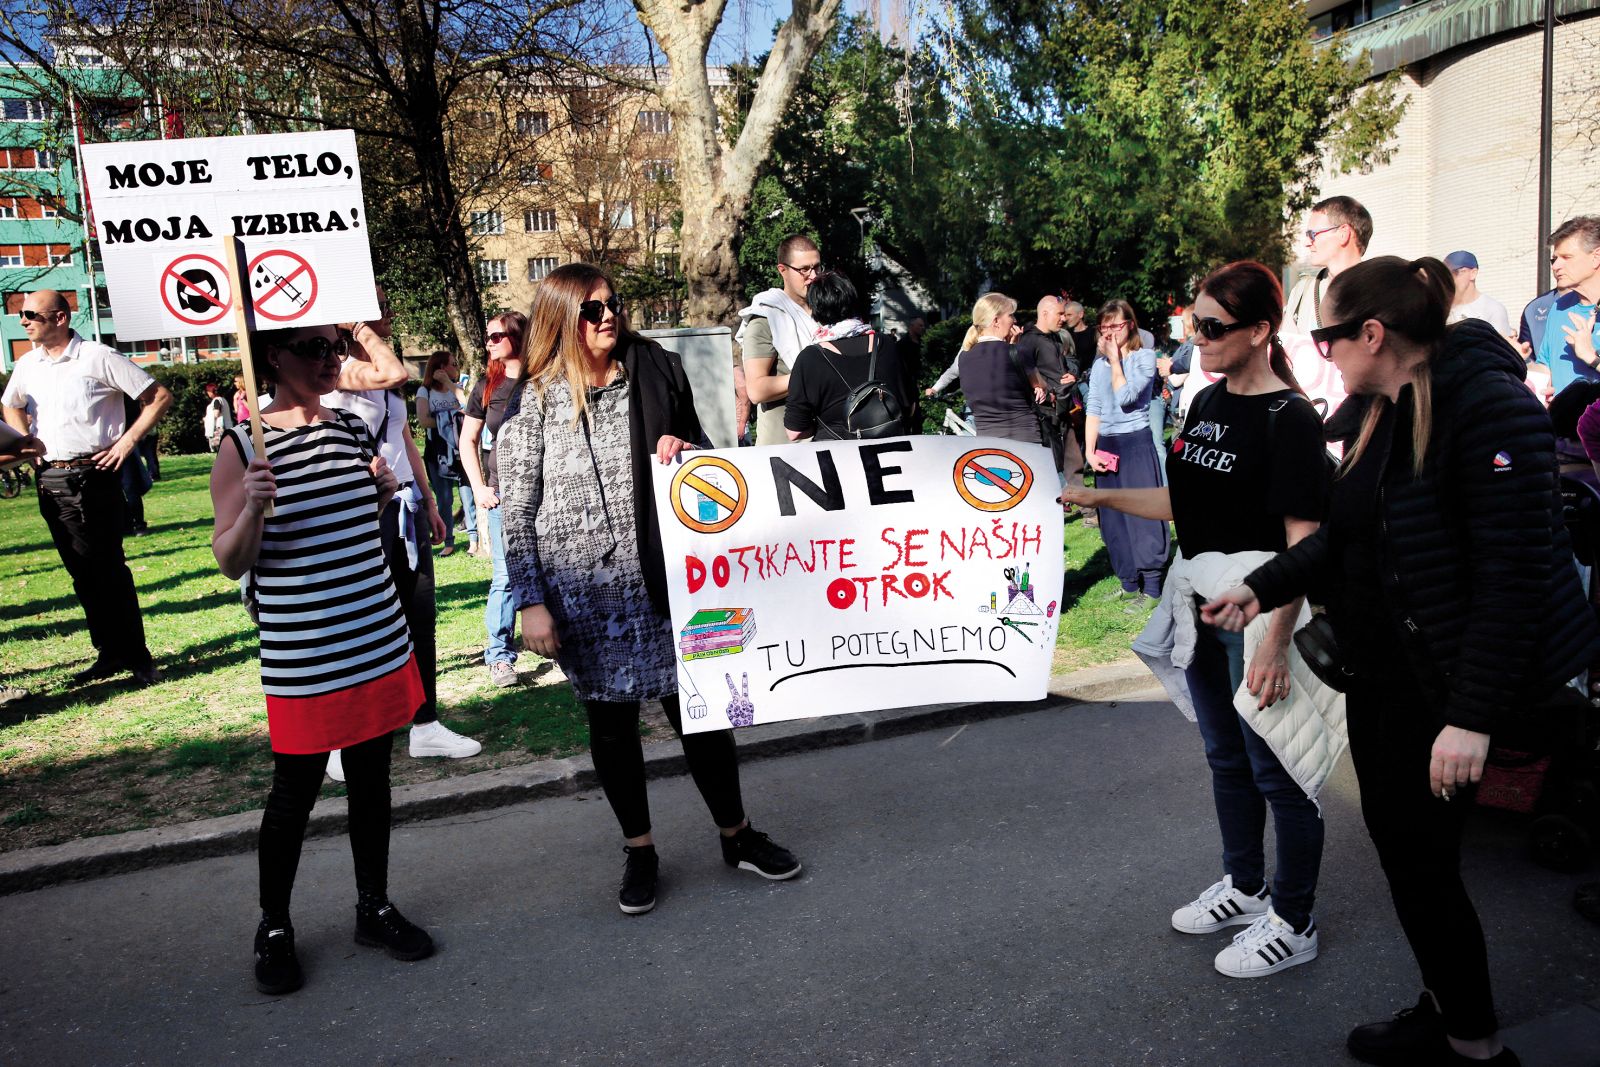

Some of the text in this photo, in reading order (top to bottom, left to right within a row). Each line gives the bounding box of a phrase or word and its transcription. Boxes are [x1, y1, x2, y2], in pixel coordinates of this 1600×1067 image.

[105, 151, 353, 189] MOJE TELO,
[102, 208, 359, 244] MOJA IZBIRA!
[769, 440, 916, 516] NE
[881, 528, 929, 572] SE
[940, 519, 1042, 561] NAŠIH
[826, 570, 955, 612] OTROK
[757, 625, 1006, 671] TU POTEGNEMO
